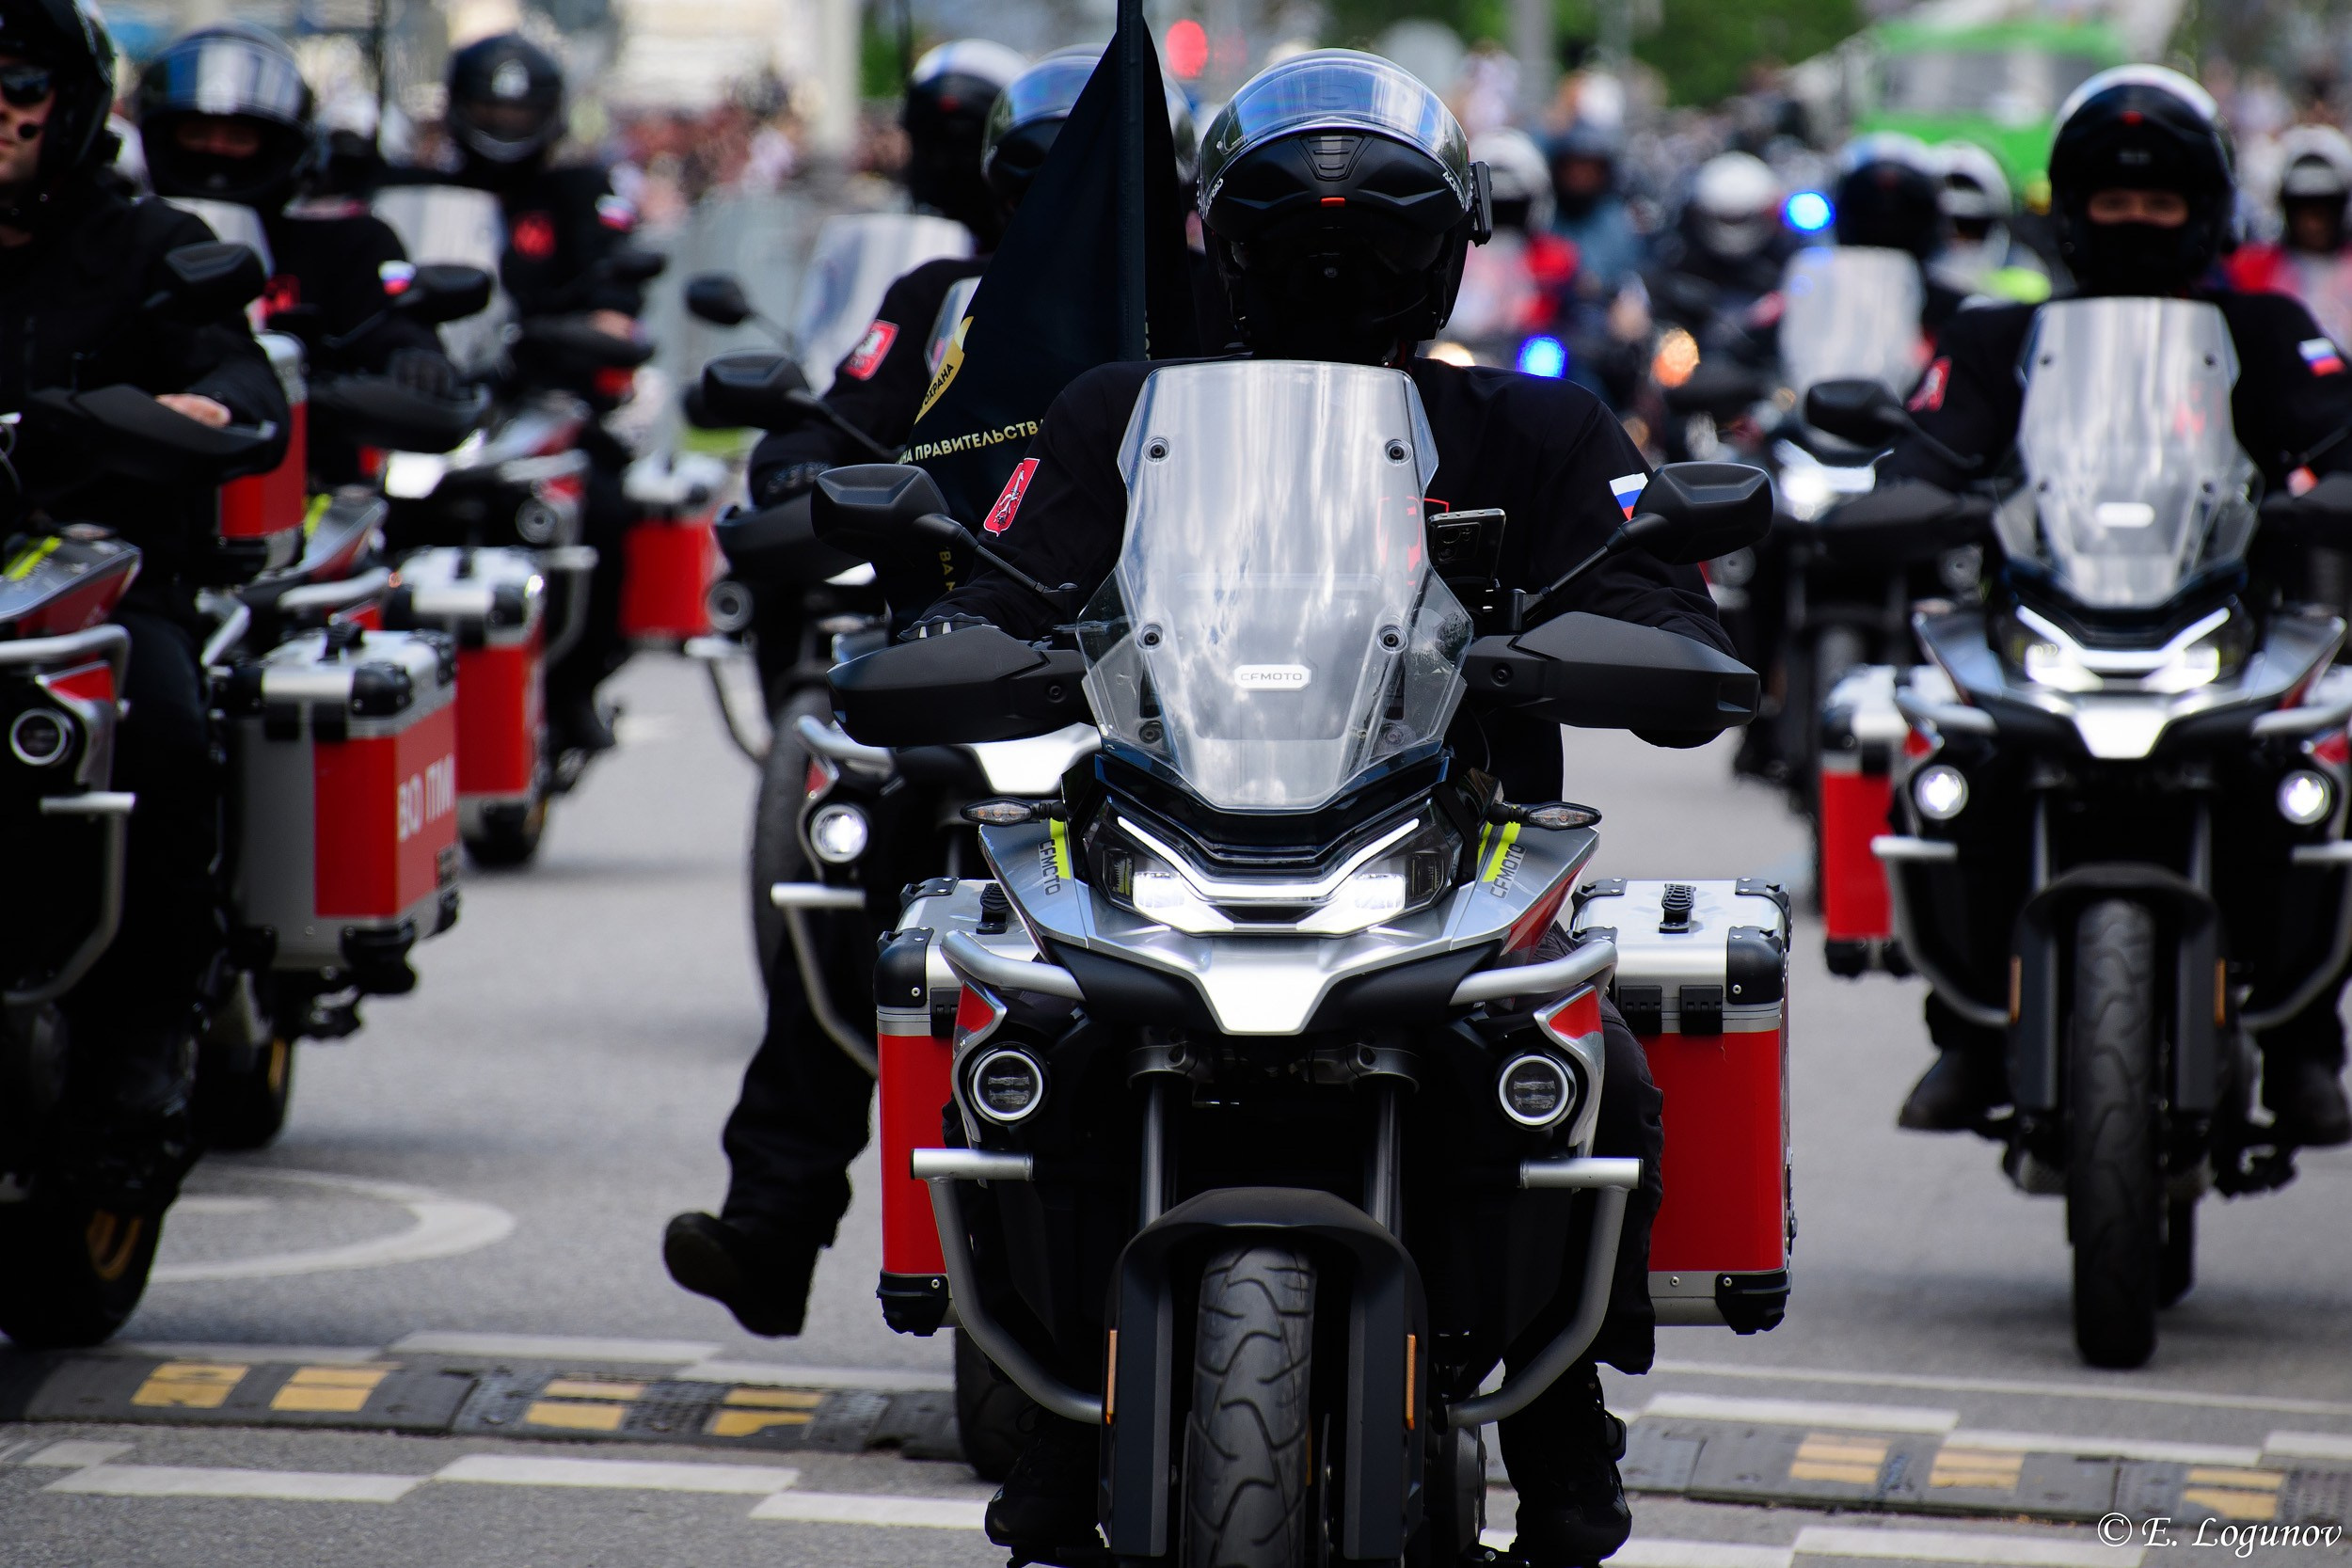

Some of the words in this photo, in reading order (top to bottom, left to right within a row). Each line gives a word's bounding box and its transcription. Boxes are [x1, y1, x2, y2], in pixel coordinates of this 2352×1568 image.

[915, 419, 1044, 460] ПРАВИТЕЛЬСТВ
[1240, 673, 1303, 681] CFMOTO
[1039, 839, 1061, 896] CFMOTO
[1489, 843, 1527, 899] CFMOTO
